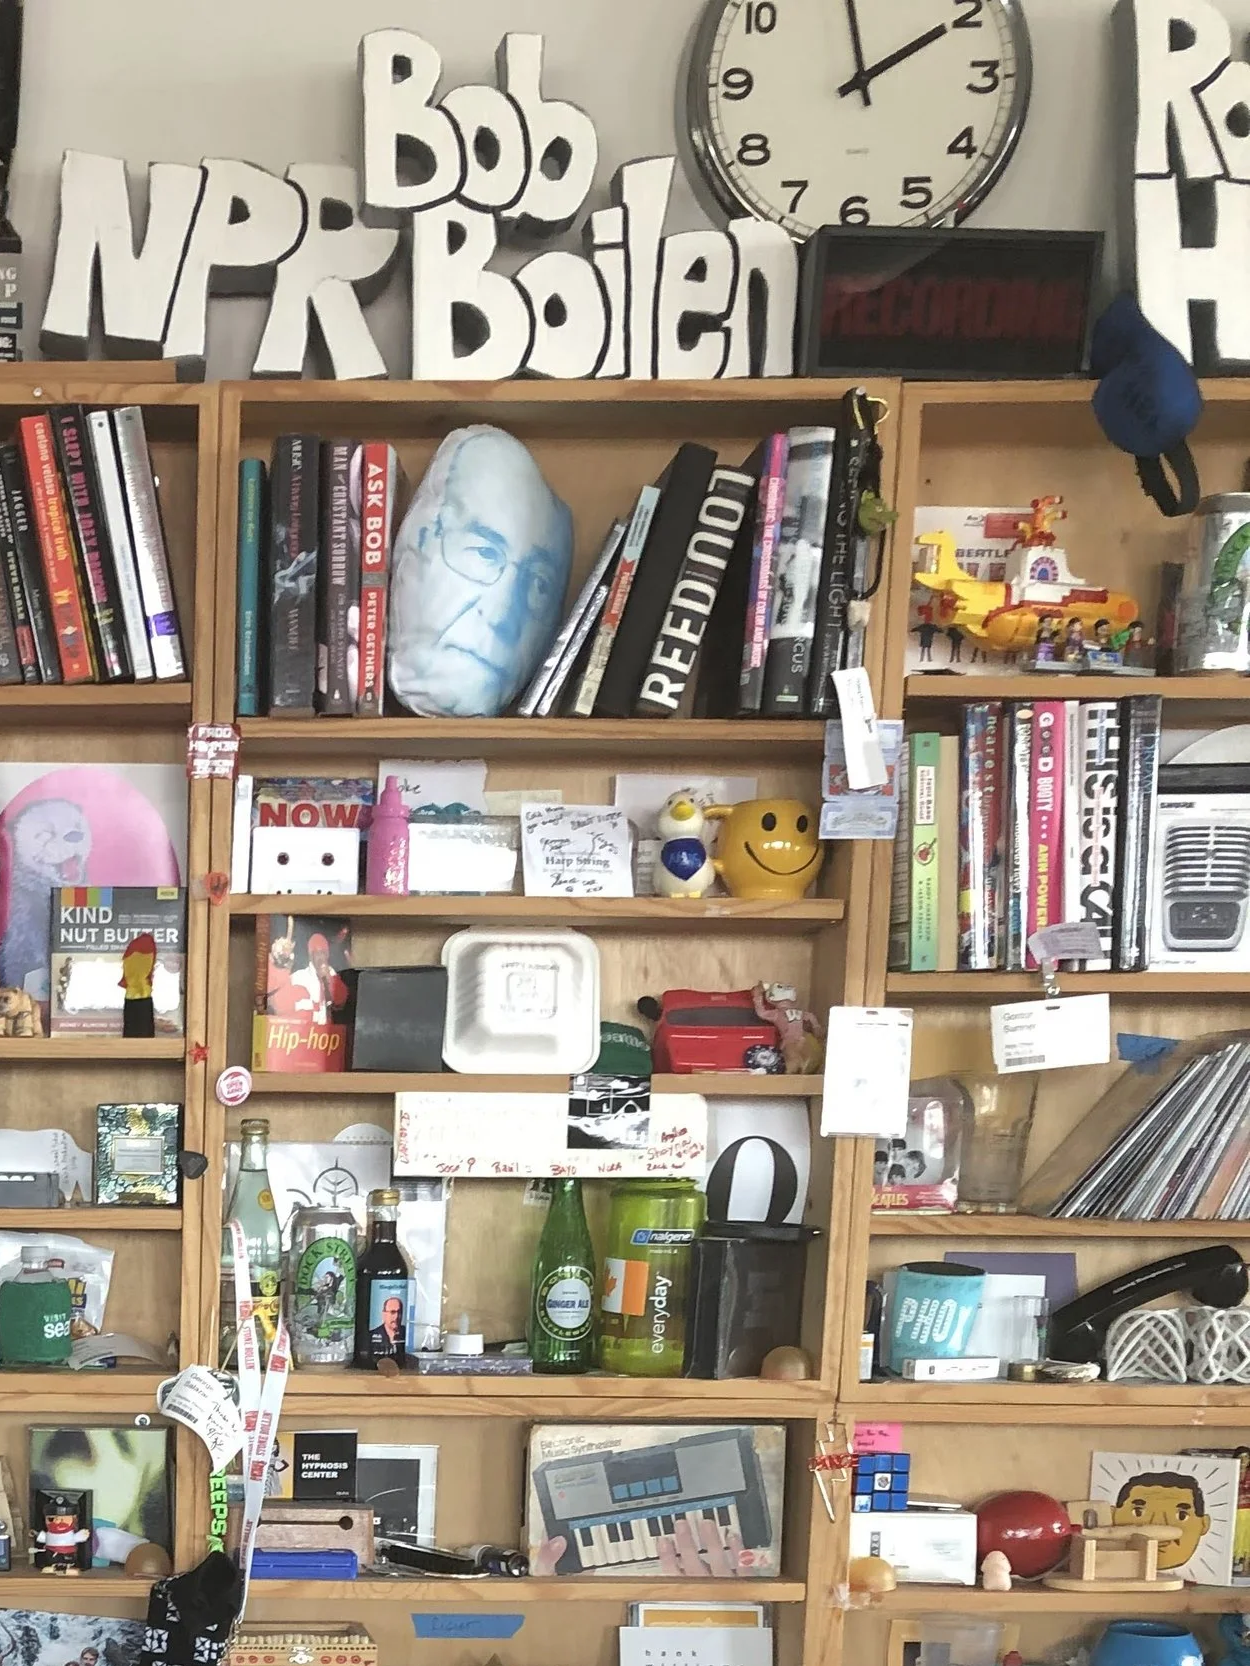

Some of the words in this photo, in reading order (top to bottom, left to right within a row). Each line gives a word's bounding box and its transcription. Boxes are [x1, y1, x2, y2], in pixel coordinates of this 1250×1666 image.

[722, 69, 754, 99] 9
[966, 60, 999, 93] 3
[362, 28, 598, 222] Bob
[740, 134, 771, 167] 8
[947, 127, 978, 159] 4
[781, 180, 807, 214] 7
[900, 176, 932, 209] 5
[41, 149, 387, 380] NPR
[413, 156, 797, 380] Boilen
[5, 283, 17, 298] P
[34, 422, 48, 462] caetano
[63, 427, 83, 467] SLEPT
[332, 446, 348, 471] MAN
[41, 463, 55, 496] veloso
[367, 462, 384, 508] ASK
[11, 490, 29, 533] JAGGER
[47, 496, 64, 538] tropical
[332, 486, 348, 540] CONSTANT
[55, 539, 67, 562] truth
[365, 516, 383, 566] BOB
[832, 534, 846, 565] THE
[331, 543, 347, 586] SORROW
[366, 592, 378, 630] PETER
[755, 601, 767, 626] COLOR
[826, 571, 846, 629] LIGHT
[639, 578, 717, 709] REED
[750, 643, 762, 668] MUSIC
[364, 633, 377, 688] GETHERS
[1036, 776, 1055, 812] BOOTY
[259, 803, 363, 828] NOW
[545, 856, 573, 868] Harp
[575, 856, 610, 868] String
[1037, 843, 1048, 873] ANN
[60, 907, 113, 924] KIND
[1036, 874, 1048, 930] POWER
[60, 928, 99, 943] NUT
[104, 927, 179, 943] BUTTER
[268, 1023, 341, 1056] Hip-hop
[651, 1231, 693, 1244] nalgene
[44, 1313, 66, 1321] VISIT
[546, 1299, 577, 1309] GINGER
[578, 1299, 590, 1309] ALE
[649, 1273, 672, 1354] everyday
[301, 1453, 321, 1461] THE
[301, 1462, 349, 1470] HYPNOSIS
[301, 1471, 338, 1479] CENTER
[645, 1649, 697, 1658] hank
